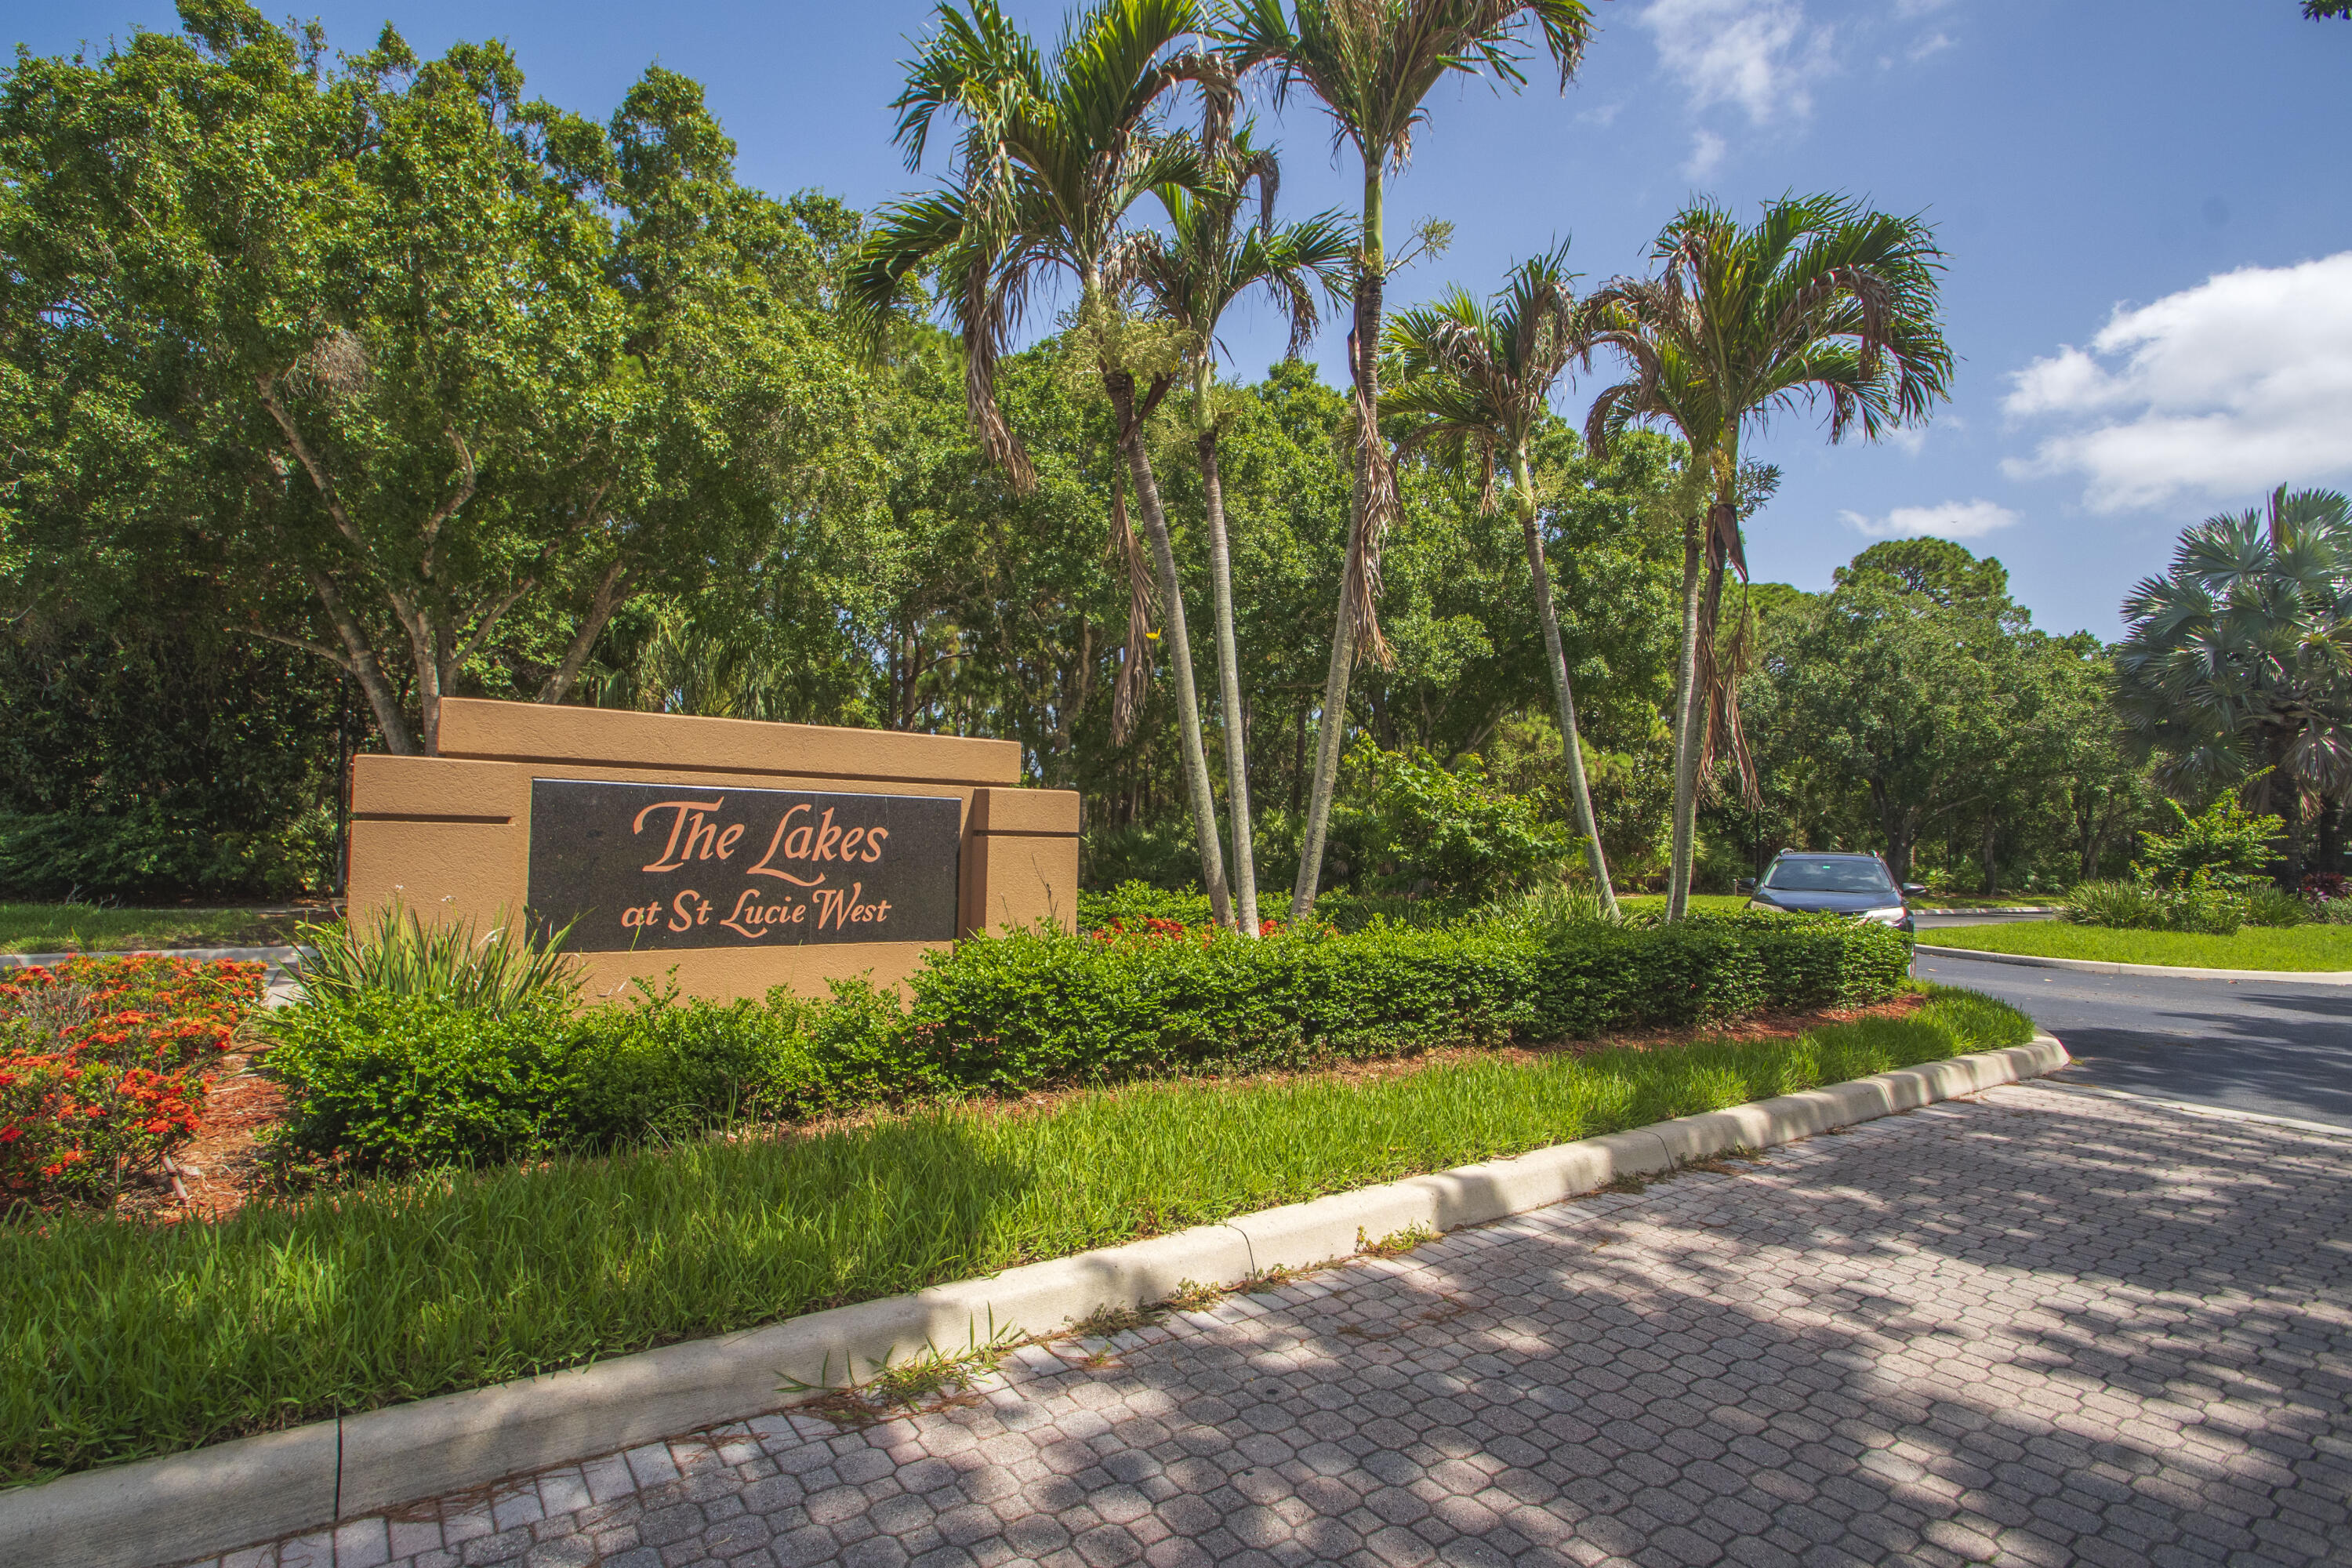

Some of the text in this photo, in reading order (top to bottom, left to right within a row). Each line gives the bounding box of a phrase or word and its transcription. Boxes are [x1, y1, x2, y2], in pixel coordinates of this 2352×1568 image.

[633, 796, 889, 887] The Lakes
[621, 882, 892, 938] at St Lucie West
